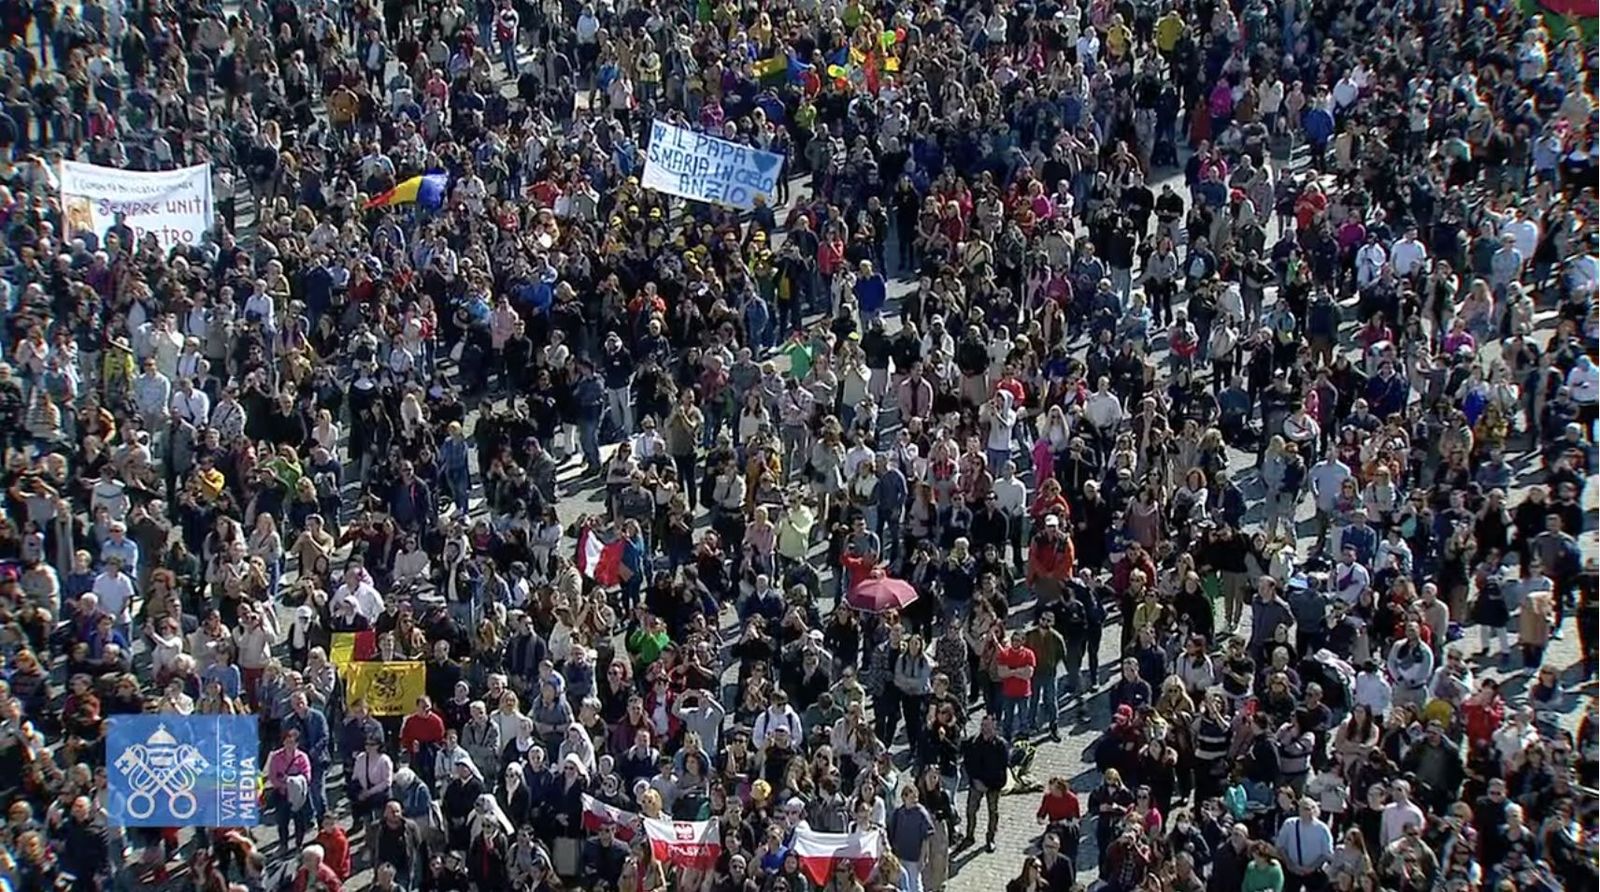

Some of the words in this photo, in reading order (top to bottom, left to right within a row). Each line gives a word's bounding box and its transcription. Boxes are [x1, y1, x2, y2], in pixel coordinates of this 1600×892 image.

[672, 127, 686, 150] IL
[694, 135, 746, 165] PAPA
[714, 162, 734, 181] IN
[678, 173, 747, 204] ANZIO
